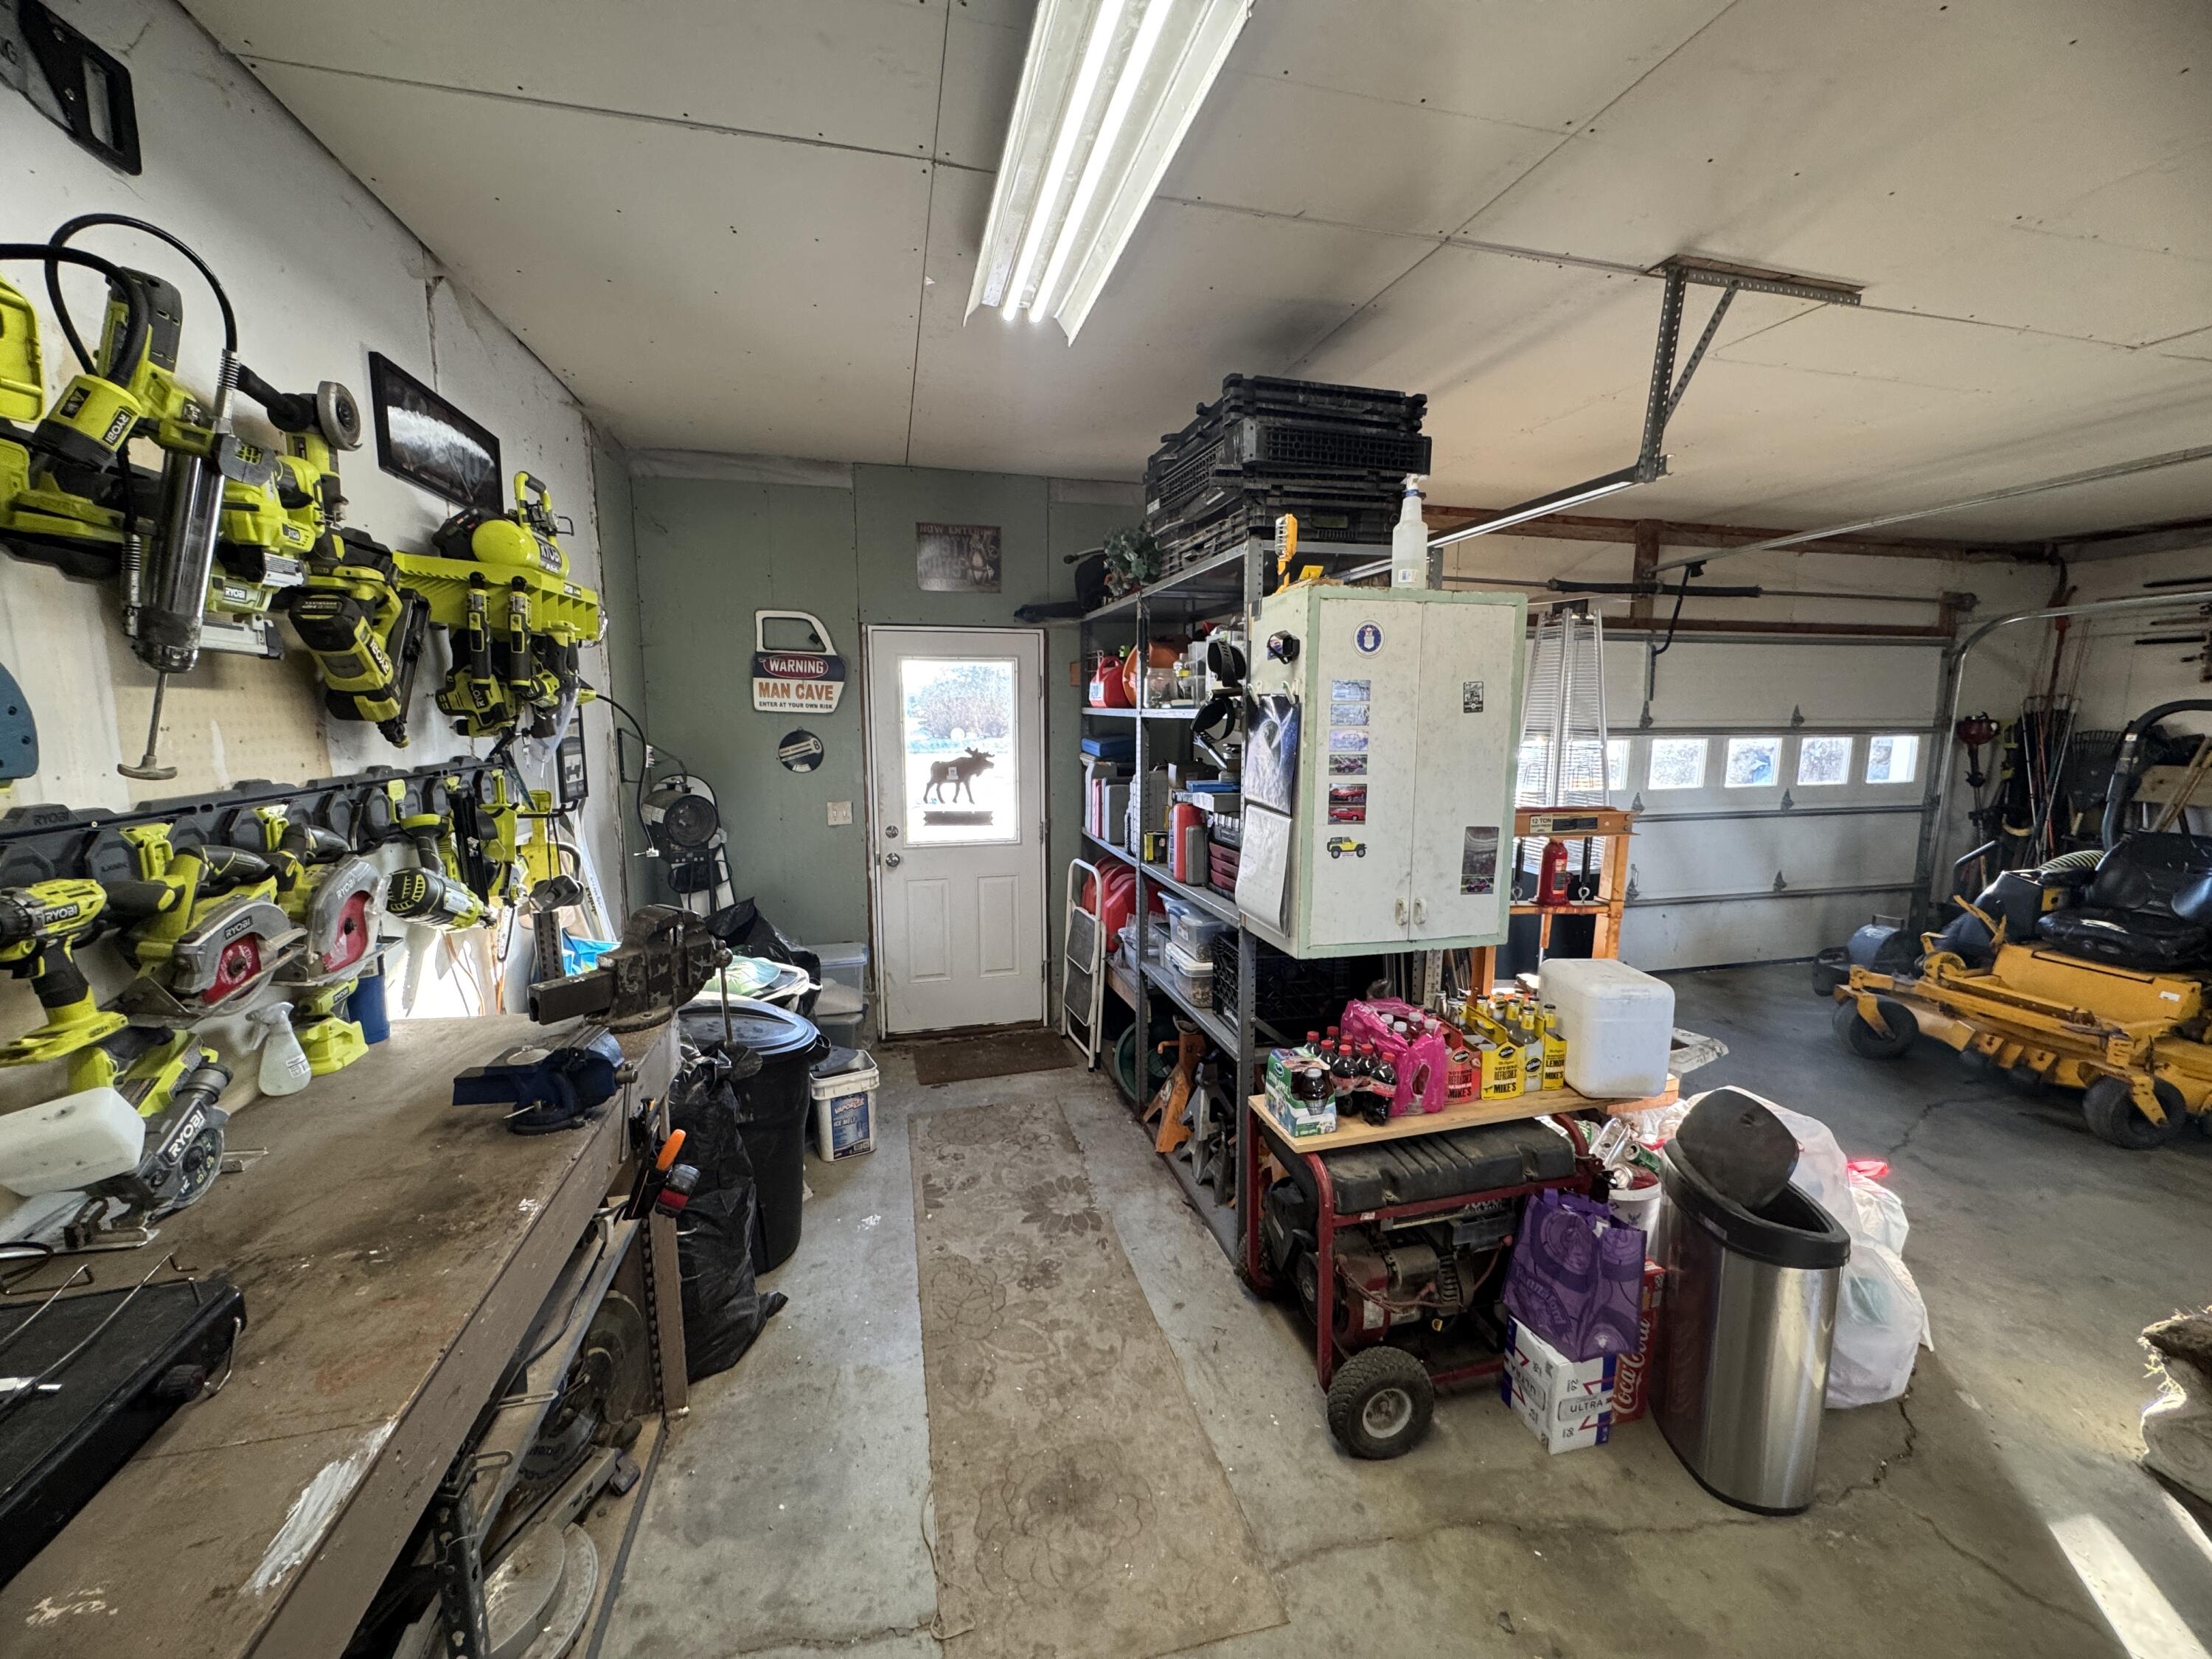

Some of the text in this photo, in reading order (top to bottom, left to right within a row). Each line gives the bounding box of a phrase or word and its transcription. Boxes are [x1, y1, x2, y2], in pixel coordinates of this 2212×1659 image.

[105, 413, 129, 444] RYOBI
[919, 524, 943, 534] NOW
[225, 587, 246, 599] RYOBI
[369, 639, 390, 675] RYOBI
[769, 659, 824, 674] WARNING
[758, 681, 834, 701] MAN CAVE
[813, 740, 821, 751] 8
[33, 811, 69, 826] RYOBI
[335, 877, 355, 900] RYOBI
[44, 905, 77, 922] RYOBI
[225, 917, 251, 938] RYOBI
[334, 987, 349, 1003] RYOBI
[1545, 1071, 1564, 1080] MIKE'S
[1447, 1087, 1472, 1099] MIKE'S
[1493, 1082, 1517, 1093] MIKE'S
[843, 1116, 856, 1125] MELT
[167, 1109, 204, 1158] RYOBI
[1570, 1399, 1604, 1413] ULTRA
